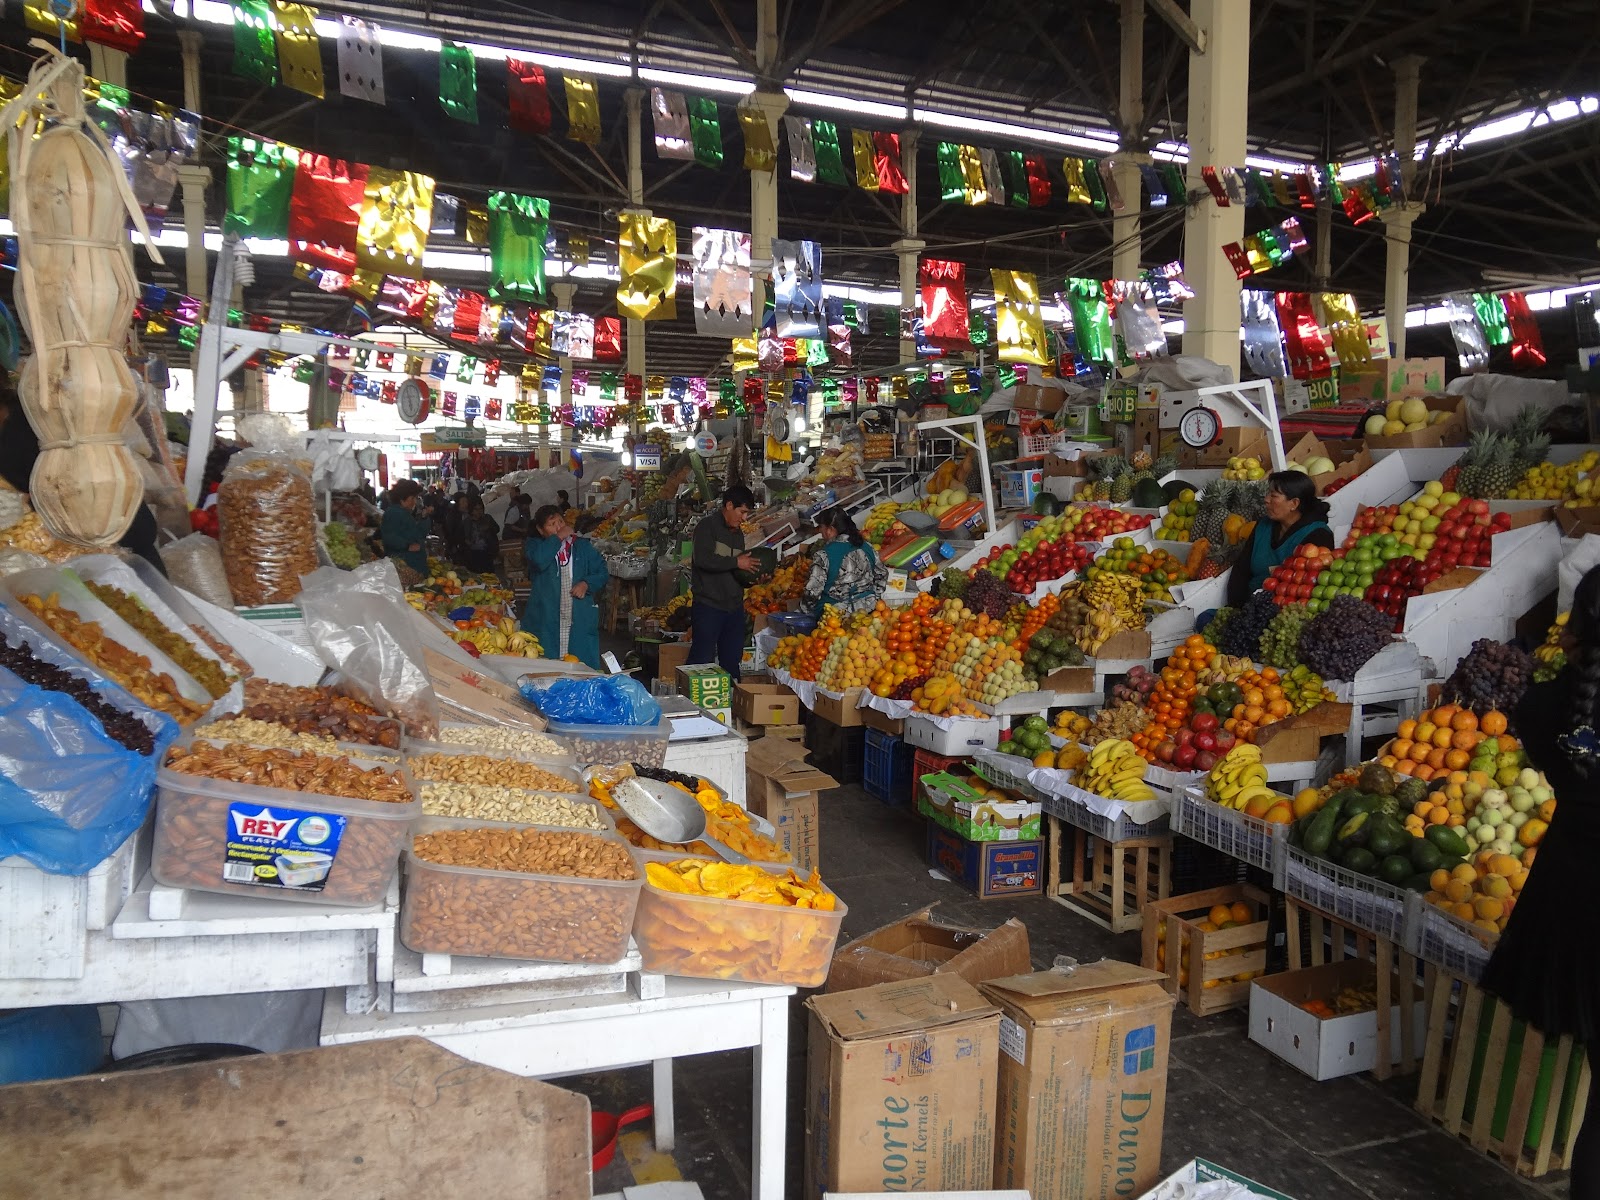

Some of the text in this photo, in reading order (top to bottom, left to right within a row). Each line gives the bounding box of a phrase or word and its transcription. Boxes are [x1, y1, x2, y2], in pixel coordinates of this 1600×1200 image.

[1309, 380, 1333, 400] BIO
[1109, 397, 1123, 412] BIO
[639, 458, 657, 466] VISA
[702, 677, 720, 709] BIO
[242, 818, 287, 838] REY
[241, 836, 279, 846] PLAST
[994, 851, 1036, 863] Granadilla
[911, 1094, 929, 1153] Kernels
[1102, 1090, 1118, 1146] Amêndoas
[1114, 1089, 1153, 1196] Duno
[1102, 1149, 1114, 1161] de
[911, 1159, 928, 1190] Nut
